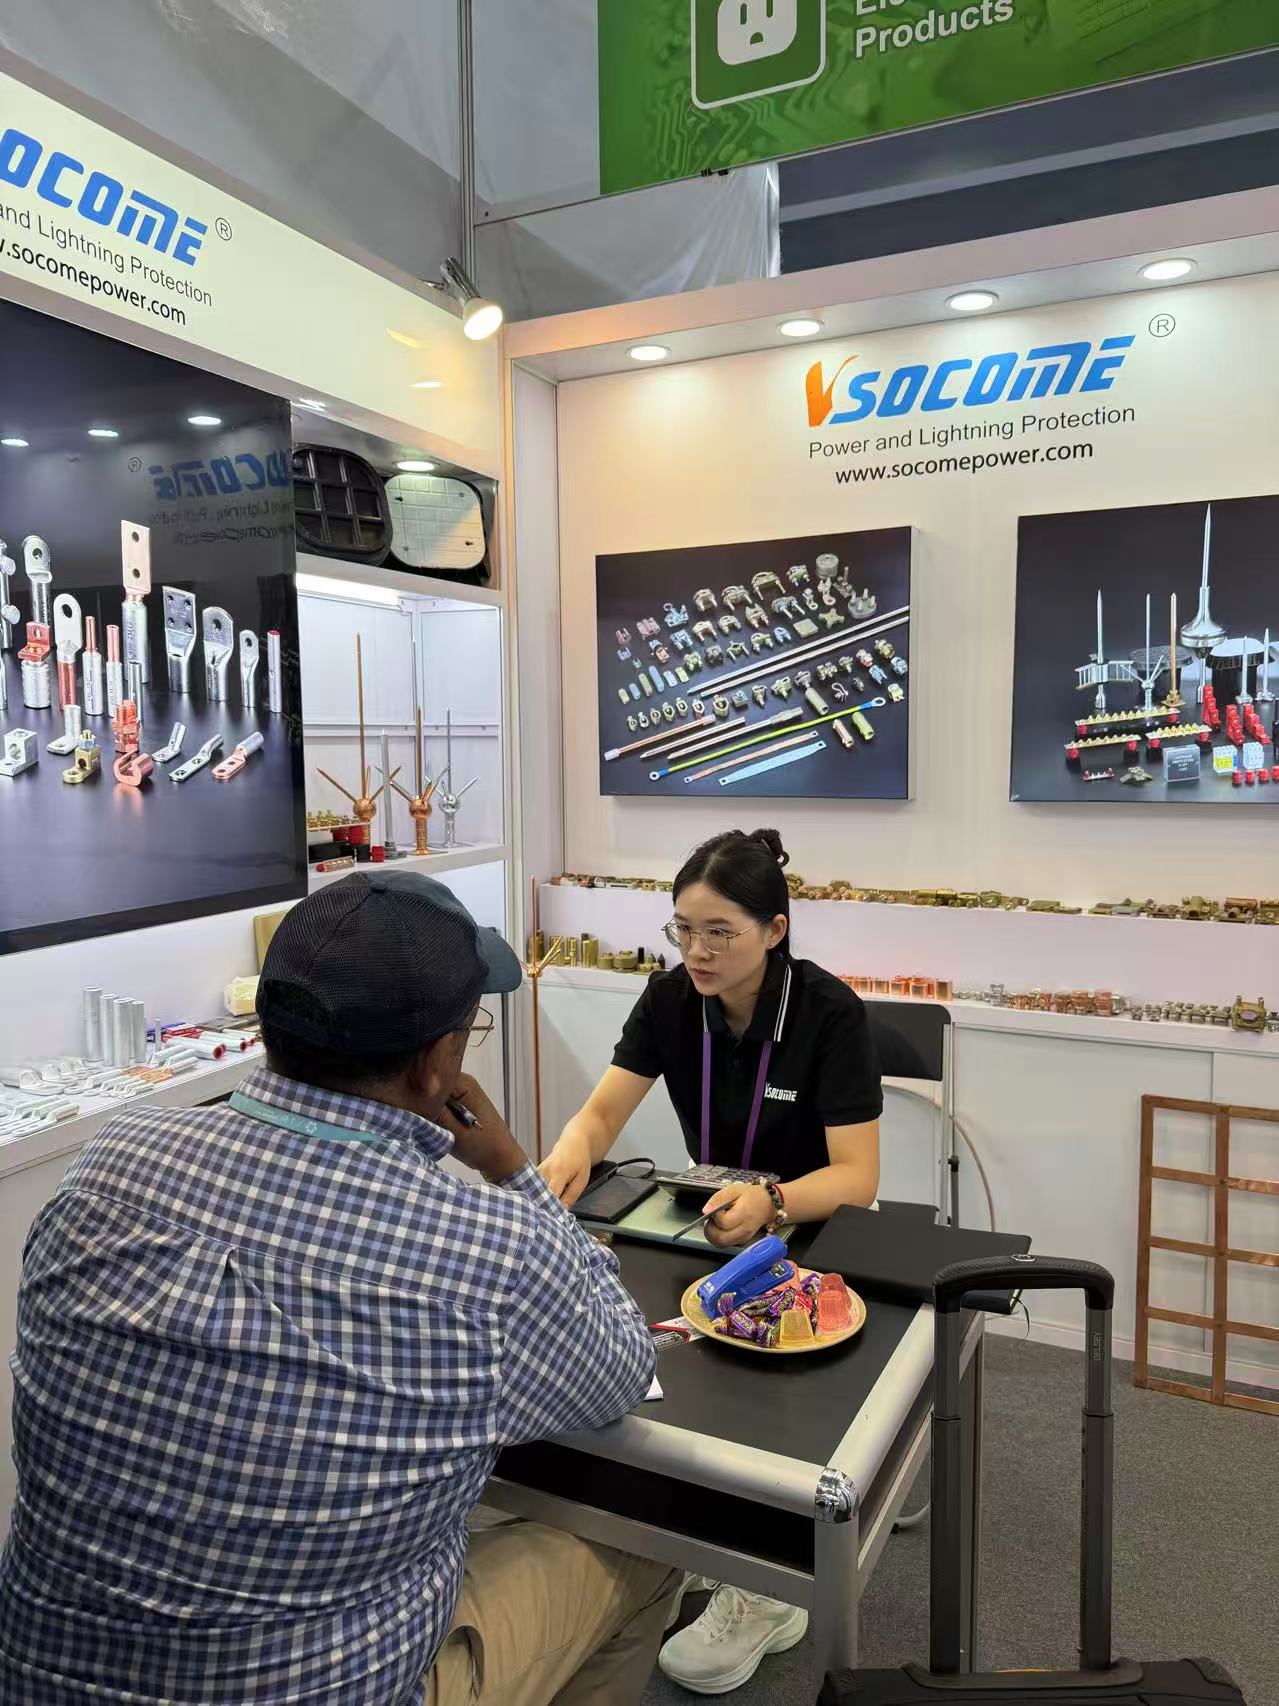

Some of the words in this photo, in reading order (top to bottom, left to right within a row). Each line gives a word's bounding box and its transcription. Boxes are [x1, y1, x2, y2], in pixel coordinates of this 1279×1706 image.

[856, 0, 1014, 58] Products
[38, 215, 124, 273] Lightning
[130, 255, 213, 307] Protection
[809, 438, 870, 459] Power
[876, 429, 912, 450] and
[919, 419, 1014, 448] Lightning
[1022, 406, 1136, 434] Protection
[835, 440, 1094, 485] www.socomepower.com
